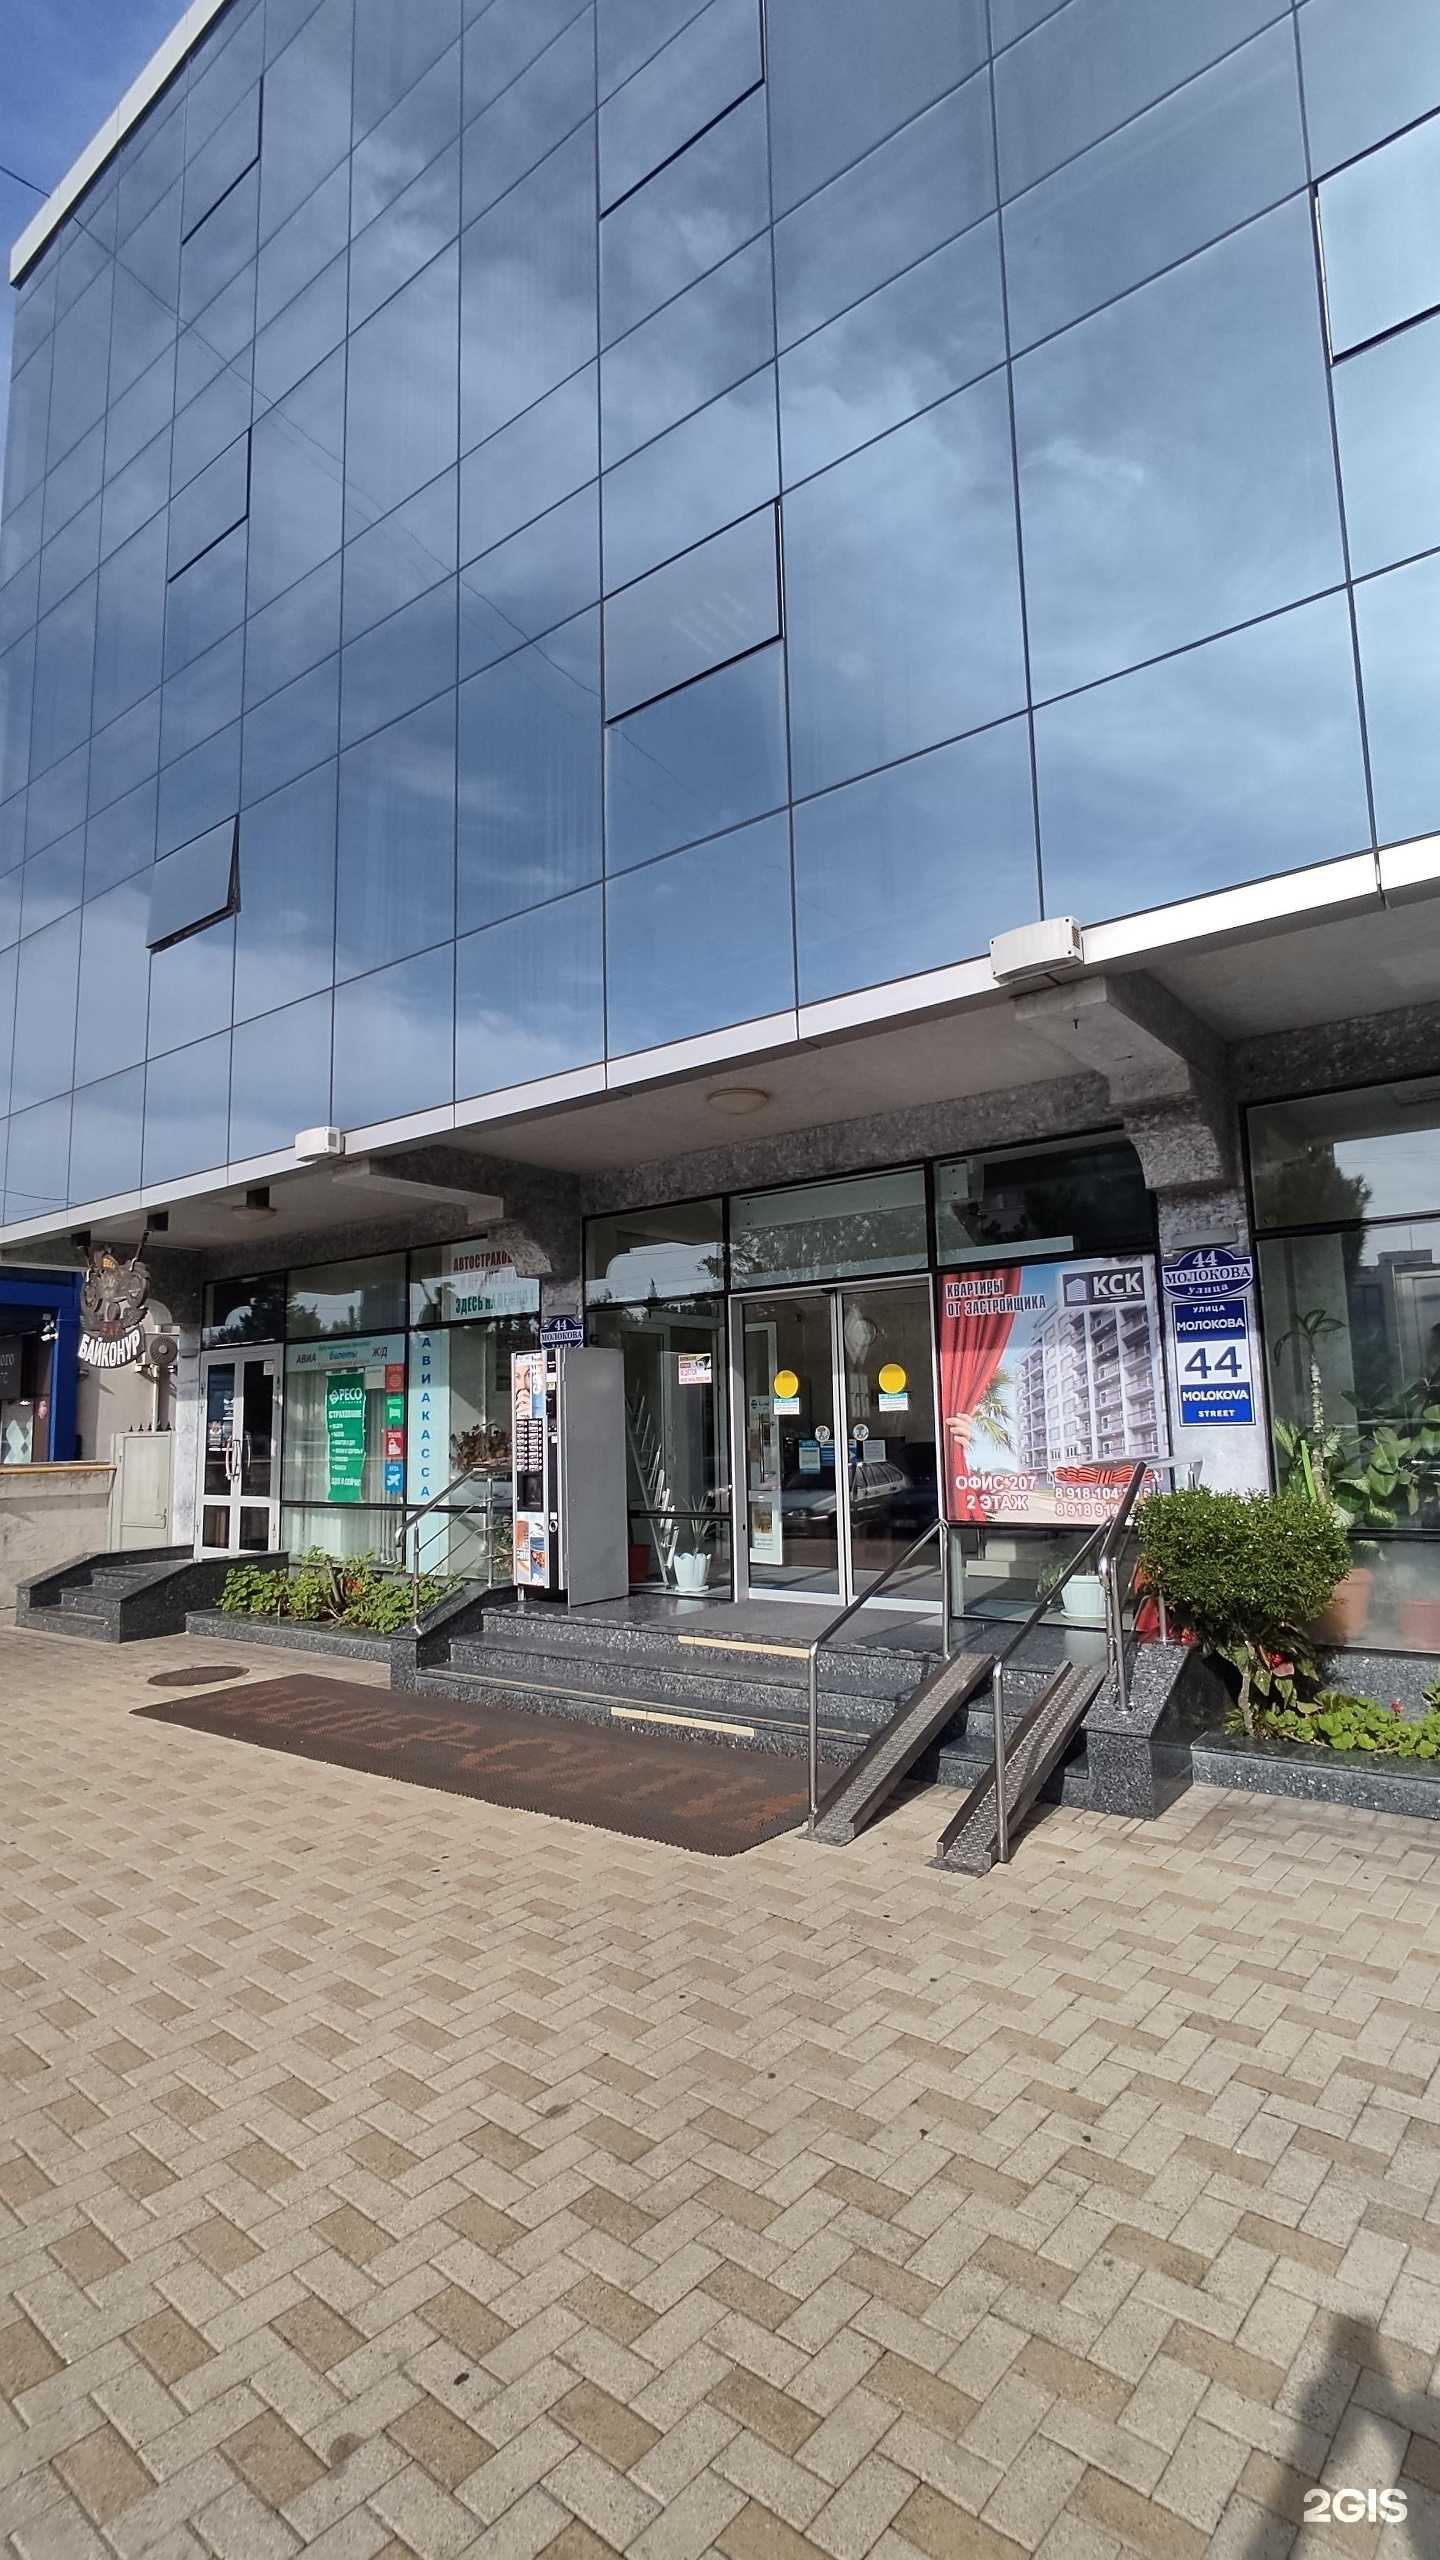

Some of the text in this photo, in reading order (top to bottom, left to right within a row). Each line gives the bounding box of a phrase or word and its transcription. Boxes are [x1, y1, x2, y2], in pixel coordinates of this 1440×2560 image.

[1192, 1251, 1218, 1267] 44
[1164, 1266, 1251, 1285] МОЛОКОВА
[946, 1279, 1003, 1298] КВАРТИРЫ
[1092, 1272, 1143, 1296] КСК
[1187, 1284, 1229, 1295] улица
[455, 1296, 483, 1316] ЗДЕСЬ
[947, 1295, 1046, 1316] ОТ ЗАСТРОЙЩИКА
[1192, 1305, 1226, 1314] УЛИЦА
[554, 1319, 567, 1331] 44
[1177, 1318, 1245, 1332] МОЛОКОВА
[541, 1330, 582, 1341] МОЛОКОВА
[78, 1328, 141, 1367] БАЙКОНУР
[296, 1352, 317, 1364] АВИА
[1184, 1346, 1242, 1379] 44
[339, 1387, 363, 1401] РЕСО
[1182, 1389, 1249, 1402] MOLOKOVA
[421, 1337, 431, 1497] АВИАКАССА
[1197, 1409, 1236, 1418] STREET
[955, 1474, 1037, 1491] ОФИС 207
[1055, 1487, 1064, 1499] 8
[1066, 1487, 1091, 1500] 918
[966, 1494, 1029, 1511] 2 ЭТАЖ
[1056, 1503, 1065, 1516] 8
[1067, 1503, 1091, 1516] 918
